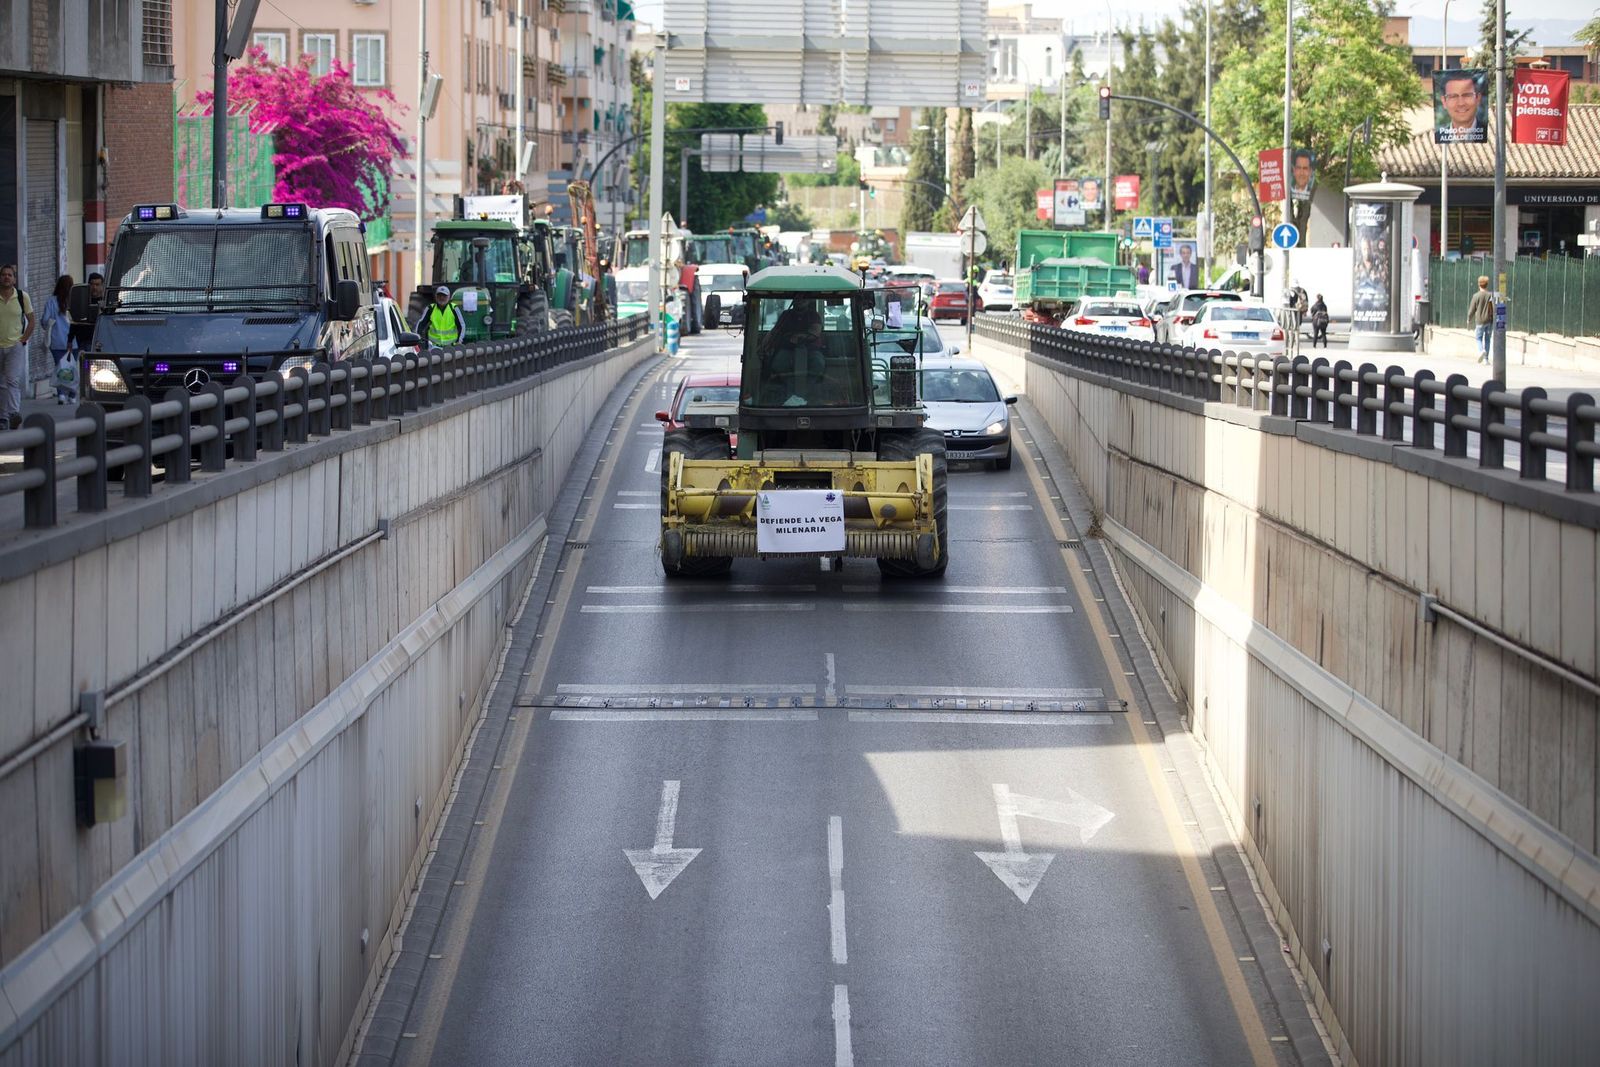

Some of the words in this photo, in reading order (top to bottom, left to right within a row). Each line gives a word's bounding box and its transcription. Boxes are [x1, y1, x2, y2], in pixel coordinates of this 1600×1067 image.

[1518, 83, 1549, 95] VOTA
[1517, 94, 1527, 104] lo
[1528, 97, 1550, 106] que
[1516, 105, 1562, 116] piensas.
[1524, 195, 1585, 203] UNIVERSIDAD
[1586, 195, 1599, 203] DE
[760, 517, 802, 525] DEFIENDE
[776, 526, 826, 534] MILENARIA
